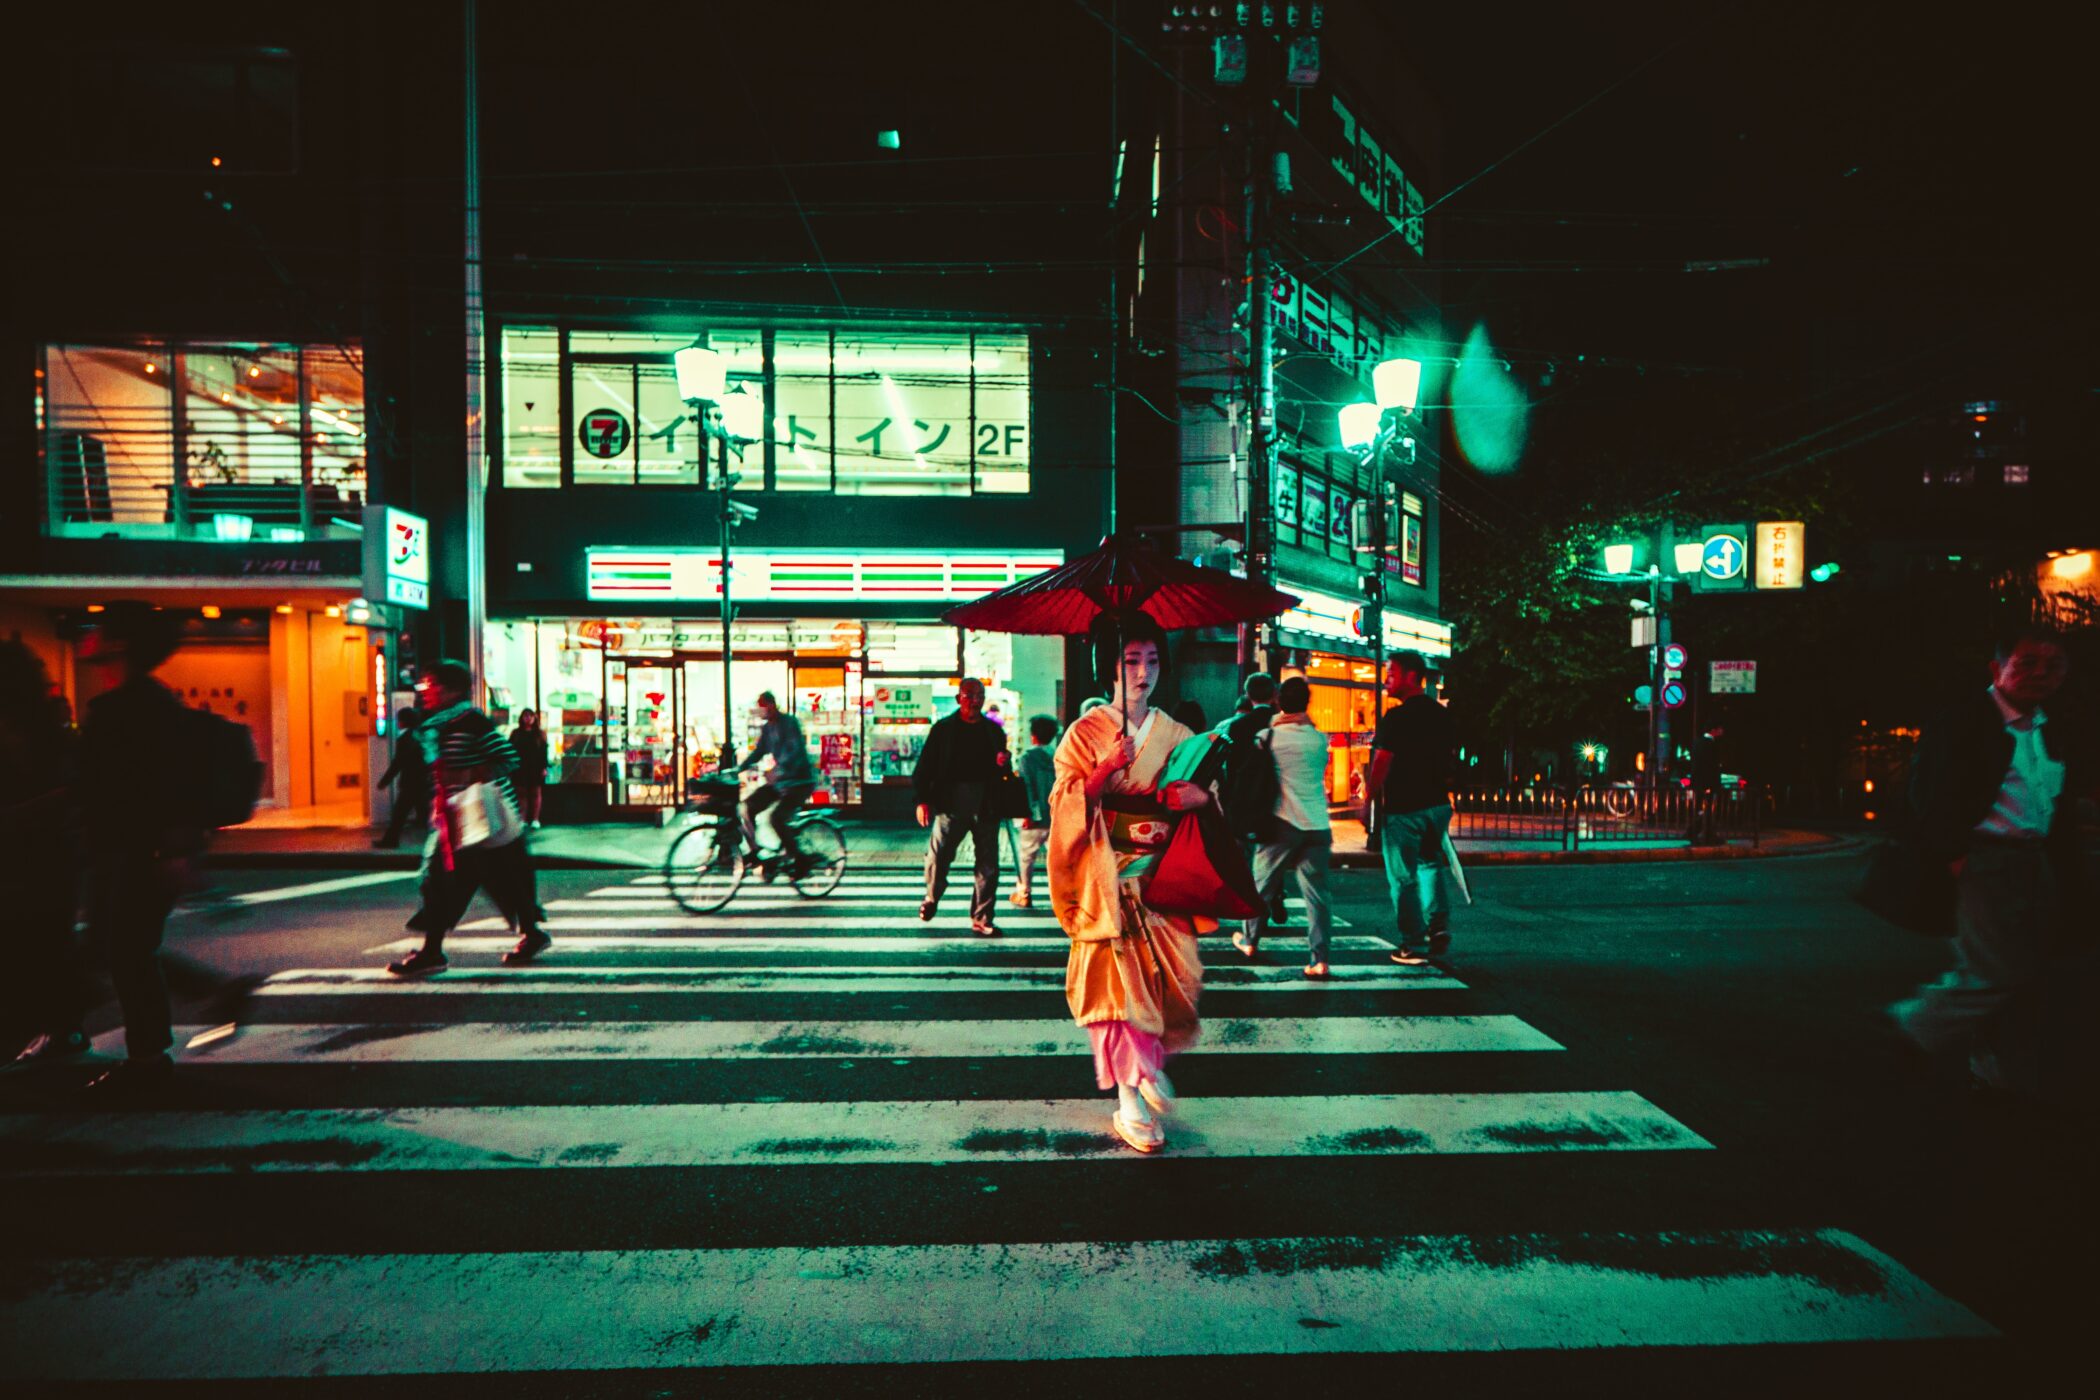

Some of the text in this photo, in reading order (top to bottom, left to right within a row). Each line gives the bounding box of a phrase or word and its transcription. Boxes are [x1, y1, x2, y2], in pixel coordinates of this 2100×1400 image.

[591, 419, 618, 456] 7
[649, 414, 1025, 456] イトイン 2F
[396, 523, 413, 556] 7
